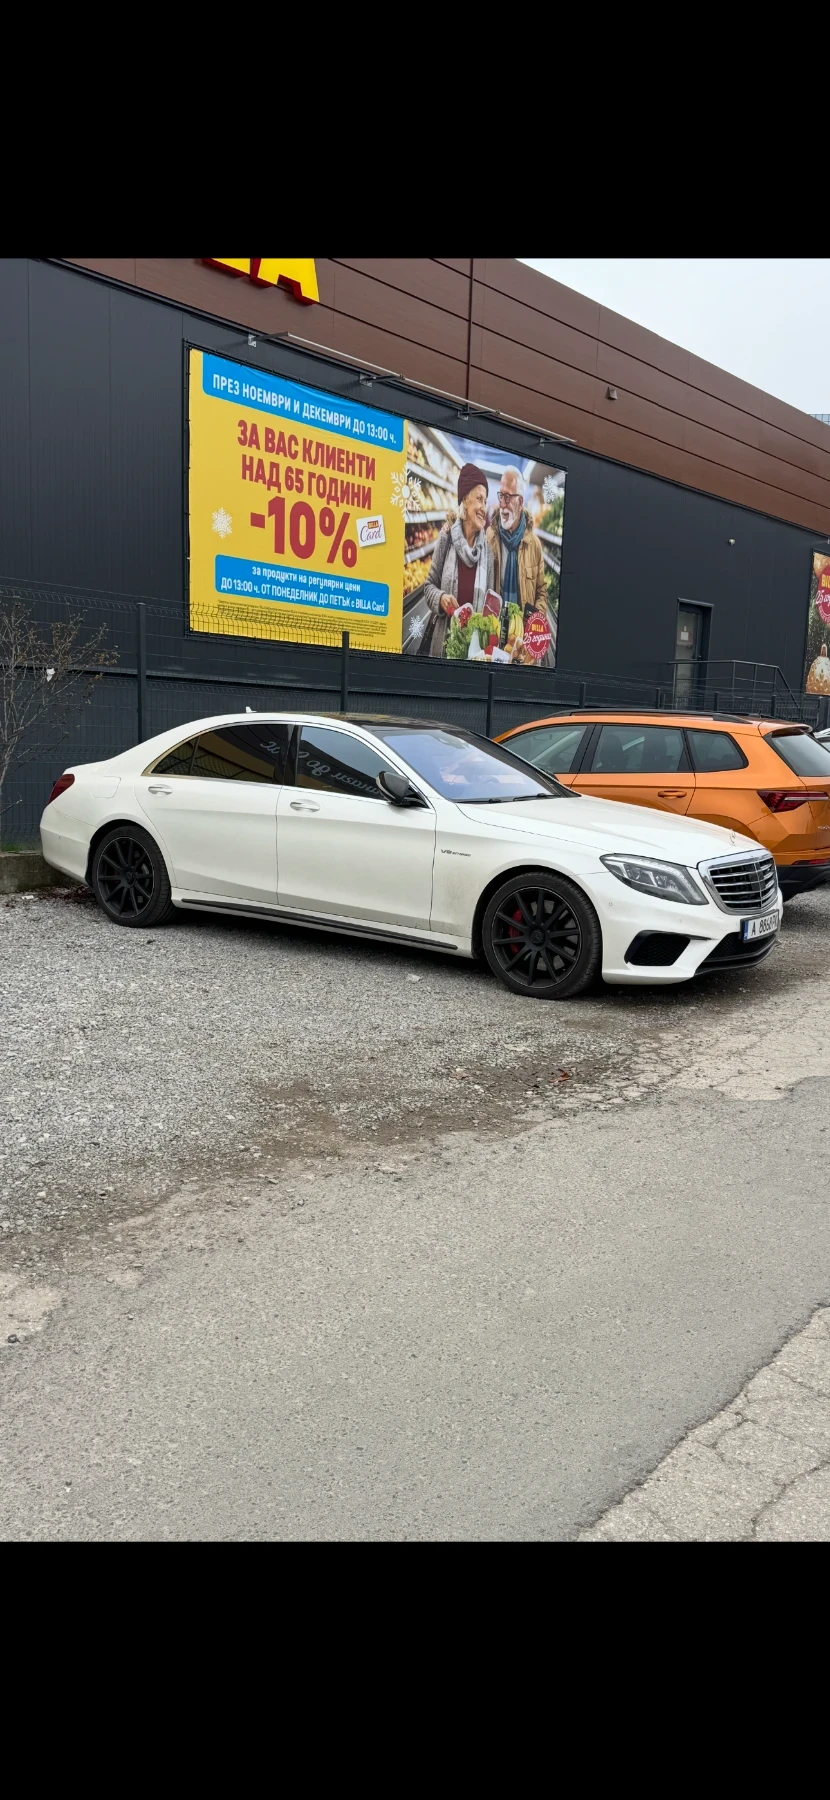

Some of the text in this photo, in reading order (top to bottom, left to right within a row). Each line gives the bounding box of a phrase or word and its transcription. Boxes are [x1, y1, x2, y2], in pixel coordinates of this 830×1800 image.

[213, 374, 397, 444] ПРЕЗ НОЕМВРИ И ДЕКЕМВРИ ДО 13:00 ч.
[237, 420, 376, 481] ЗА ВАС КЛИЕНТИ
[241, 454, 372, 510] НАД 65 ГОДИНИ
[250, 496, 357, 568] -10%
[360, 524, 382, 542] Card
[221, 577, 232, 591] ДО
[233, 578, 252, 592] 13:00
[254, 585, 260, 594] ч.
[261, 583, 271, 595] ОТ
[272, 585, 318, 602] ПОНЕДЕЛНИК
[319, 593, 329, 605] ДО
[330, 594, 351, 607] ПЕТЪК
[355, 599, 371, 611] BILLA
[372, 602, 385, 613] Card
[252, 566, 361, 593] за продукти на регулярни цени
[815, 590, 824, 604] 25
[523, 632, 533, 645] 25
[531, 624, 544, 632] BILLA
